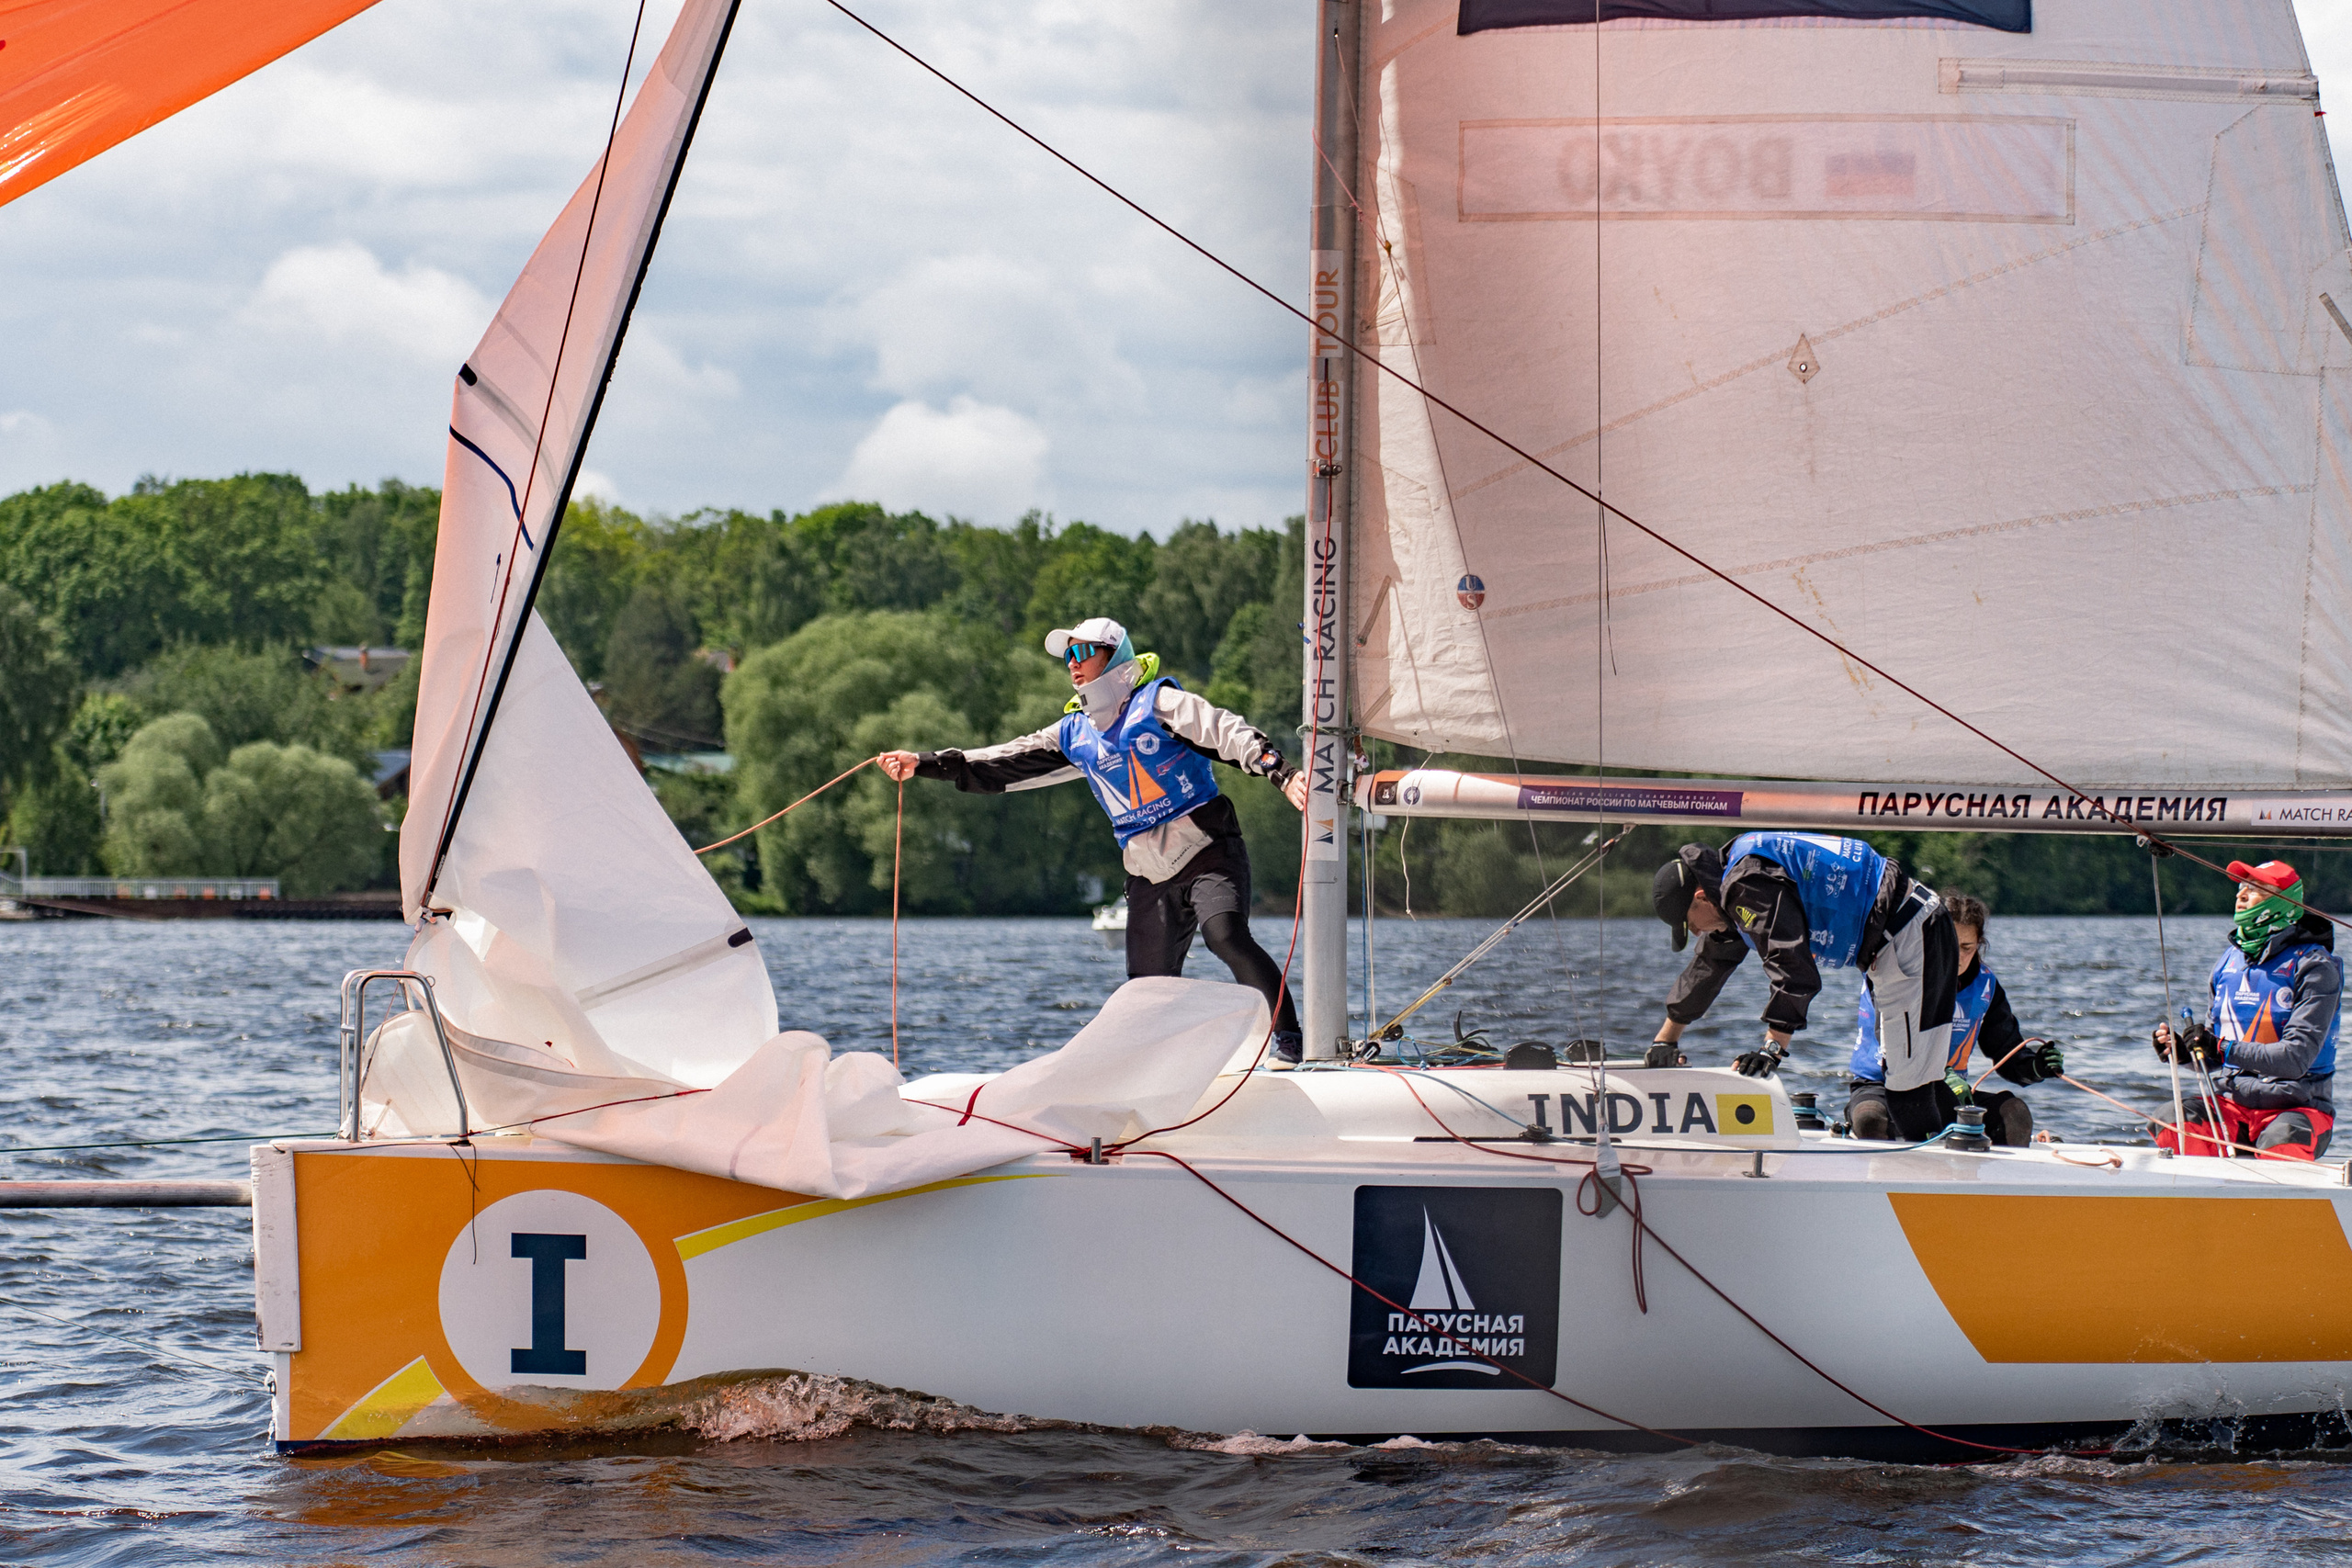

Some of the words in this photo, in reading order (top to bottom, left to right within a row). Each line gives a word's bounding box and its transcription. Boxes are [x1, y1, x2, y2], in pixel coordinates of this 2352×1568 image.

[1315, 267, 1340, 356] TOUR
[1315, 380, 1340, 459] CLUB
[1313, 536, 1338, 662] RACING
[1312, 678, 1336, 795] MACH
[1136, 797, 1171, 818] RACING
[1531, 795, 1585, 806] ЧЕМПИОНАТ
[1586, 797, 1623, 807] РОССИИ
[1623, 799, 1636, 808] ПО
[1637, 799, 1689, 809] МАТЧЕВЫМ
[1690, 801, 1728, 811] ГОНКАМ
[1858, 791, 2032, 818] ПАРУСНАЯ
[2041, 795, 2228, 824] АКАДЕМИЯ
[2279, 807, 2333, 821] MATCH
[1527, 1092, 1718, 1134] INDIA
[510, 1232, 587, 1376] I
[1387, 1313, 1524, 1334] ПАРУСНАЯ
[1382, 1337, 1525, 1358] АКАДЕМИЯ
